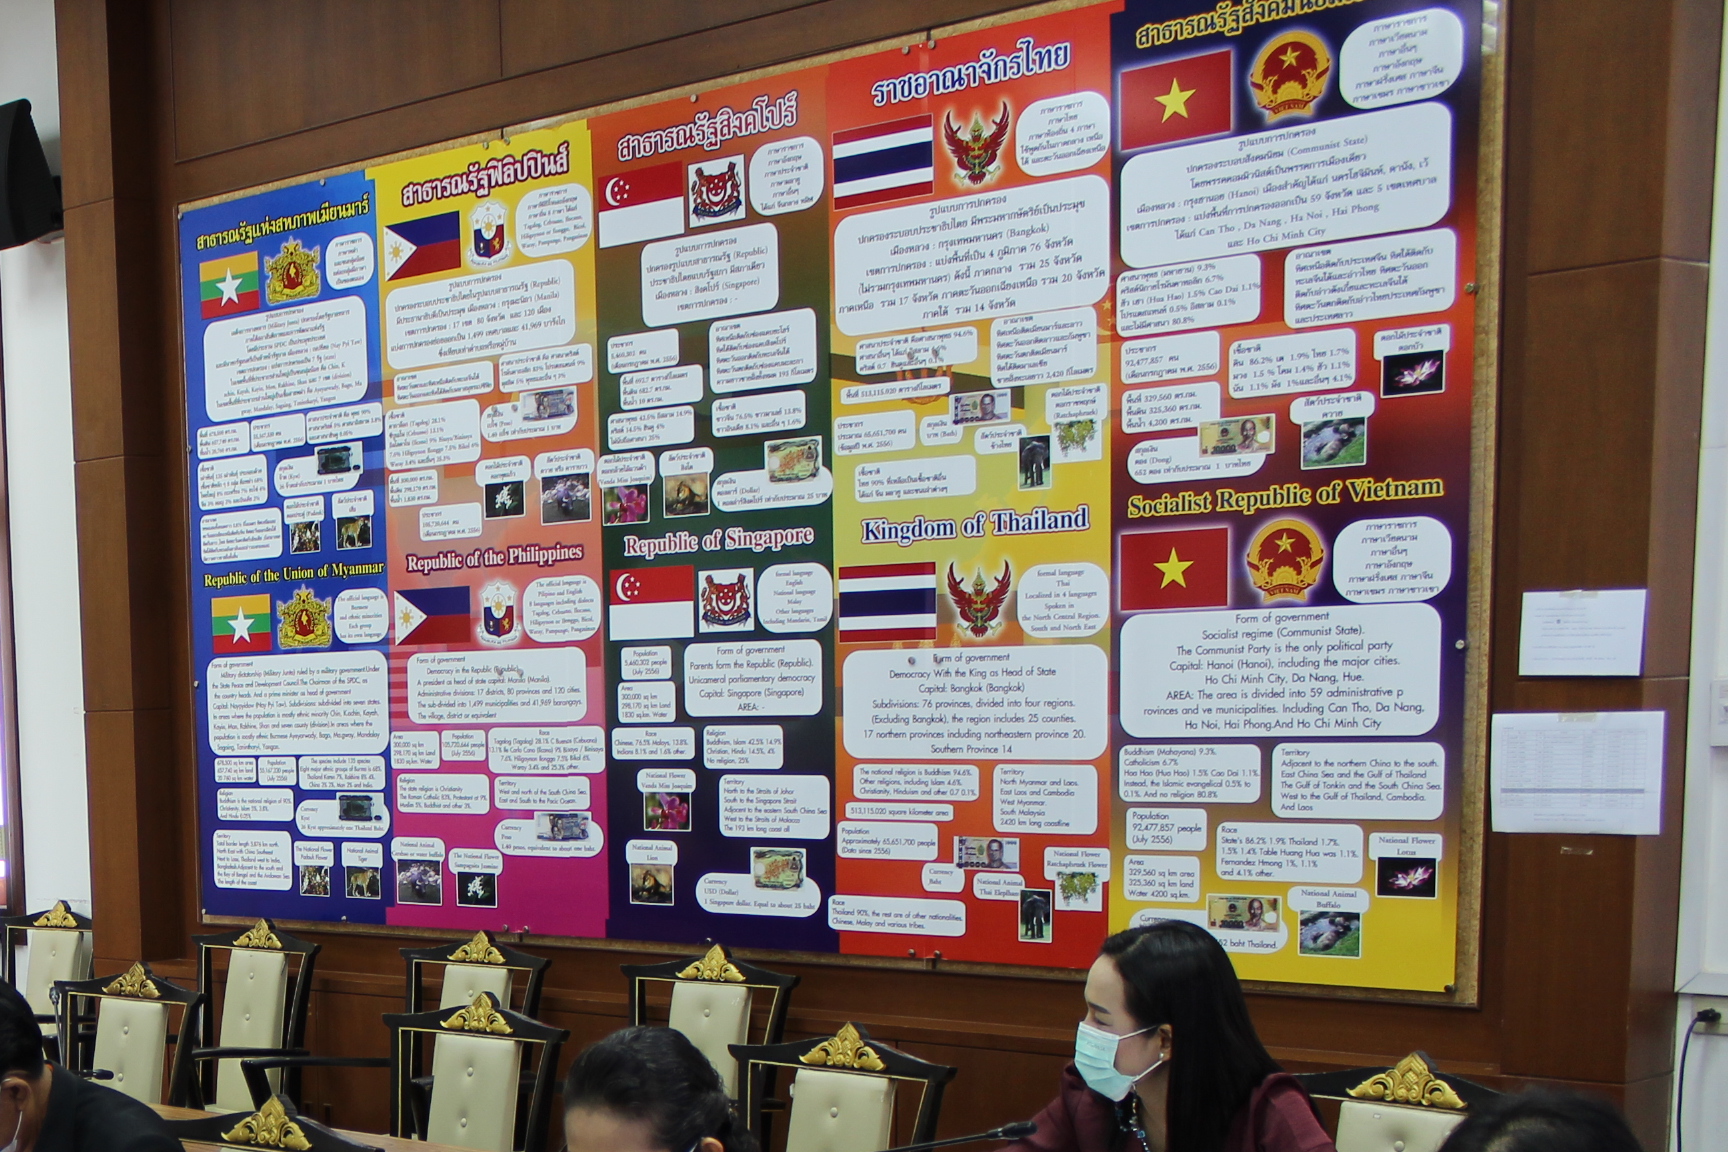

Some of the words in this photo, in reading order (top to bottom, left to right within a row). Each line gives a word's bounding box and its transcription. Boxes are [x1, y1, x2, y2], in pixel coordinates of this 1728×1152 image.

[871, 38, 1070, 107] ราชอาณาจักรไทย
[617, 92, 797, 162] สาธารณรัฐสิงคโปร์
[402, 141, 569, 206] สาธารณรัฐฟิลิปปินส์
[196, 193, 370, 250] สาธารณรัฐแห่งสหภาพเมียนมาร์
[1129, 491, 1210, 517] Socialist
[1218, 485, 1310, 514] Republic
[1317, 482, 1340, 503] of
[1348, 478, 1443, 501] Vietnam
[863, 517, 956, 544] Kingdom
[963, 511, 985, 537] of
[992, 506, 1088, 534] Thailand
[625, 532, 698, 558] Republic
[702, 529, 721, 550] of
[725, 528, 813, 551] Singapore
[407, 554, 462, 574] Republic
[467, 551, 480, 567] of
[484, 549, 505, 565] the
[509, 545, 583, 566] Philippines
[204, 571, 247, 588] Republic
[250, 570, 261, 583] of
[264, 568, 280, 582] the
[283, 566, 314, 580] Union
[317, 564, 329, 578] of
[332, 562, 384, 578] Myanmar
[1235, 613, 1258, 623] Form
[1261, 611, 1272, 622] of
[1274, 611, 1329, 625] government
[1202, 628, 1238, 640] Socialist
[1241, 628, 1273, 641] regime
[1276, 625, 1332, 638] (Communist
[716, 646, 733, 655] Form
[735, 644, 743, 654] of
[745, 645, 785, 656] government
[1176, 645, 1192, 655] The
[1195, 644, 1244, 655] Communist
[1247, 643, 1271, 656] Party
[1285, 641, 1299, 652] the
[1302, 640, 1323, 654] only
[1326, 639, 1363, 654] political
[1367, 640, 1393, 653] party
[689, 661, 713, 670] Parents
[715, 659, 731, 669] form
[733, 659, 744, 668] the
[746, 658, 775, 670] Republic
[954, 652, 962, 662] of
[964, 653, 1010, 664] government
[1207, 659, 1233, 669] Hanoi
[1277, 656, 1320, 670] including
[1323, 656, 1338, 666] the
[1341, 655, 1370, 669] major
[688, 674, 726, 684] Unicameral
[728, 673, 775, 685] parliamentary
[777, 672, 815, 683] democracy
[889, 669, 931, 680] Democracy
[933, 667, 952, 677] With
[954, 667, 966, 677] the
[968, 668, 986, 679] King
[1001, 666, 1022, 676] Head
[1025, 666, 1034, 676] of
[1036, 666, 1056, 676] State
[1205, 675, 1218, 684] Ho
[1221, 673, 1237, 684] Chi
[1240, 672, 1263, 683] Minh
[1291, 672, 1305, 682] Da
[727, 688, 762, 699] Singapore
[764, 687, 804, 699] (Singapore)
[950, 682, 983, 695] Bangkok
[985, 681, 1025, 694] (Bangkok)
[1197, 688, 1213, 699] The
[1251, 687, 1285, 698] divided
[1288, 688, 1306, 698] into
[1310, 687, 1322, 698] 59
[1326, 686, 1393, 697] administrative
[922, 698, 932, 708] 76
[975, 697, 1004, 707] divided
[1007, 698, 1022, 707] into
[1024, 697, 1040, 707] four
[1181, 703, 1198, 714] and
[1282, 702, 1324, 715] Including
[1327, 702, 1347, 713] Can
[1375, 701, 1389, 712] Da
[871, 714, 909, 726] (Excluding
[951, 713, 963, 723] the
[966, 714, 990, 725] region
[993, 713, 1025, 723] includes
[1028, 713, 1038, 723] 25
[1184, 720, 1197, 729] Ha
[1223, 719, 1239, 729] Hai
[1297, 718, 1310, 728] Ho
[1313, 717, 1330, 728] Chi
[1333, 717, 1358, 728] Minh
[1362, 717, 1382, 730] City
[864, 729, 874, 738] 17
[875, 728, 906, 738] northern
[909, 729, 944, 740] provinces
[947, 728, 981, 740] including
[984, 728, 1032, 738] northeastern
[1034, 729, 1069, 740] province
[930, 743, 963, 753] Southern
[966, 744, 998, 753] Province
[1002, 744, 1012, 753] 14
